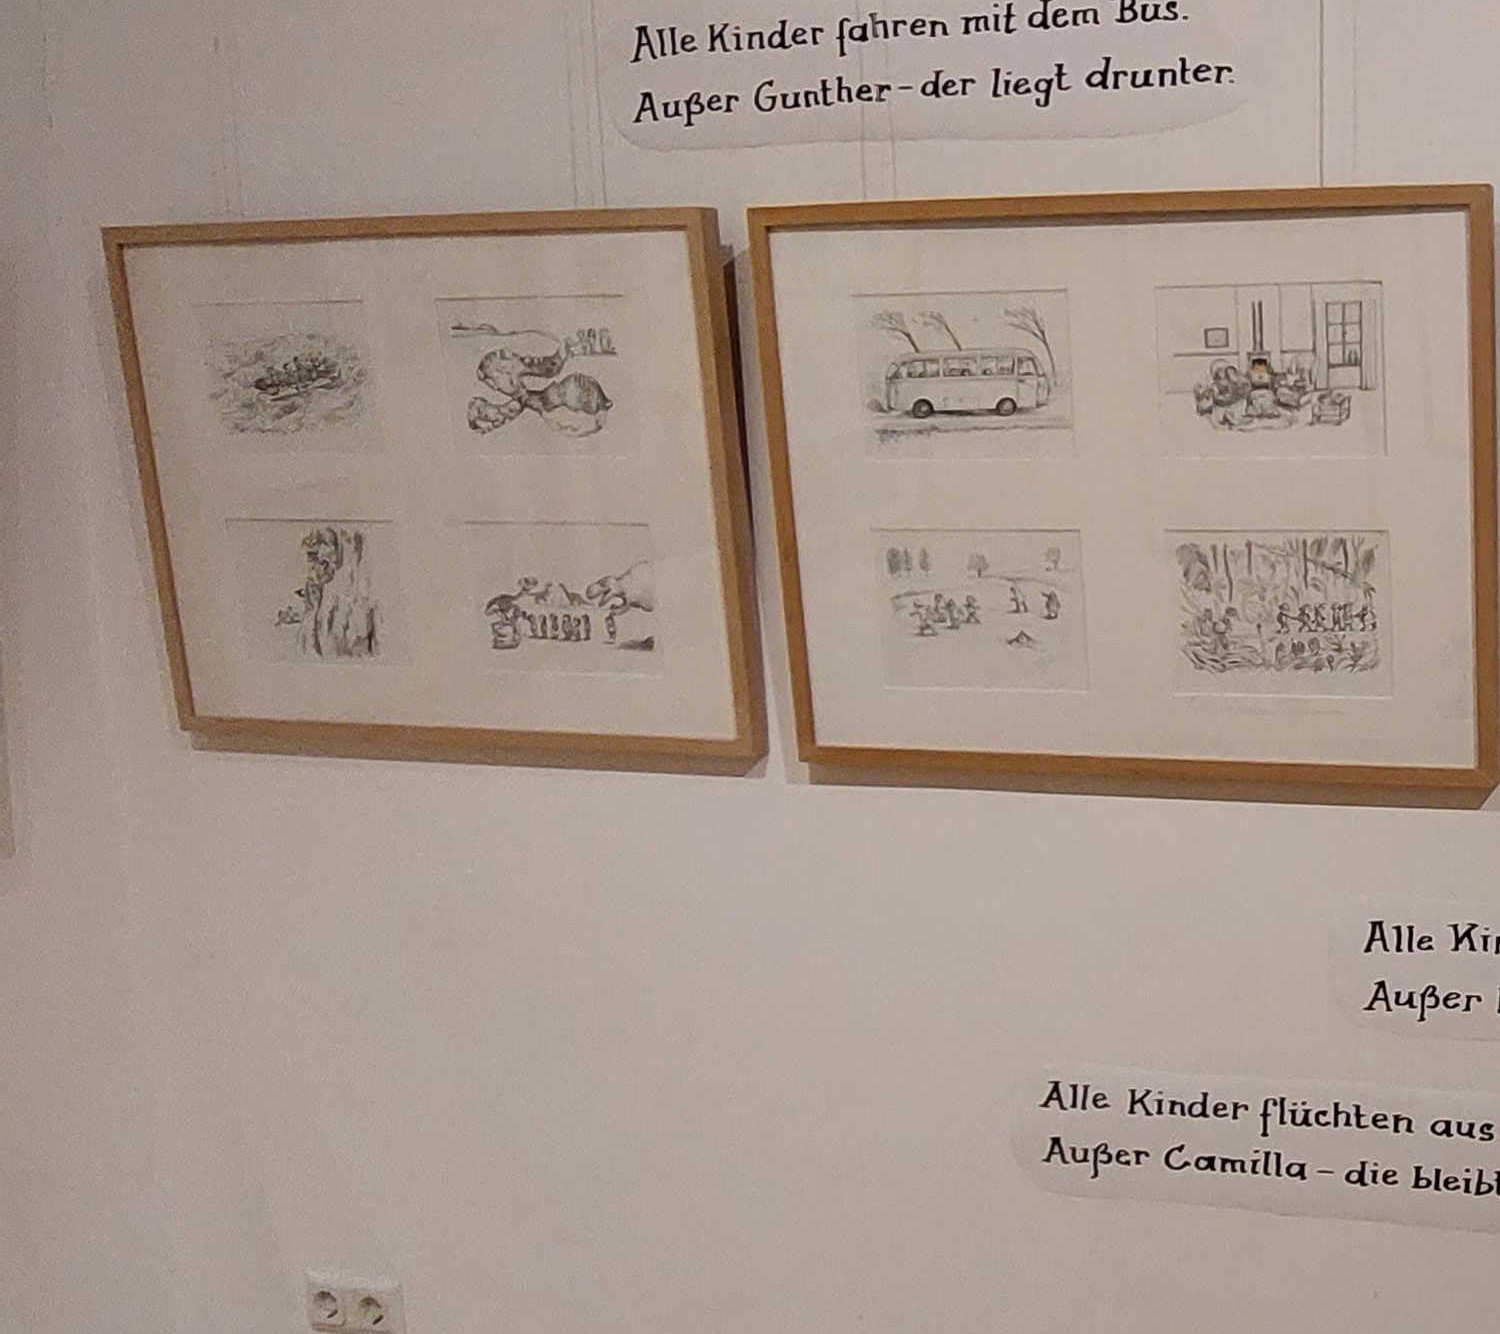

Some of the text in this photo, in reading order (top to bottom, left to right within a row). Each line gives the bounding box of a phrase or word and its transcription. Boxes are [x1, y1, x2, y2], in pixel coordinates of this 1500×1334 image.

[629, 25, 699, 64] Alle
[707, 19, 825, 53] Kinder
[835, 13, 950, 58] fahren
[959, 2, 1018, 36] mit
[632, 91, 740, 128] Außer
[991, 62, 1073, 108] liegt
[1084, 56, 1235, 91] drunter.
[1362, 920, 1435, 954] Alle
[1362, 979, 1483, 1023] Außer
[1038, 1080, 1112, 1111] Alle
[1127, 1088, 1250, 1121] Kinder
[1258, 1096, 1415, 1138] flüchten
[1429, 1119, 1495, 1142] aus
[1041, 1136, 1151, 1180] Außer
[1163, 1143, 1308, 1181] Camilla
[1344, 1160, 1399, 1188] die
